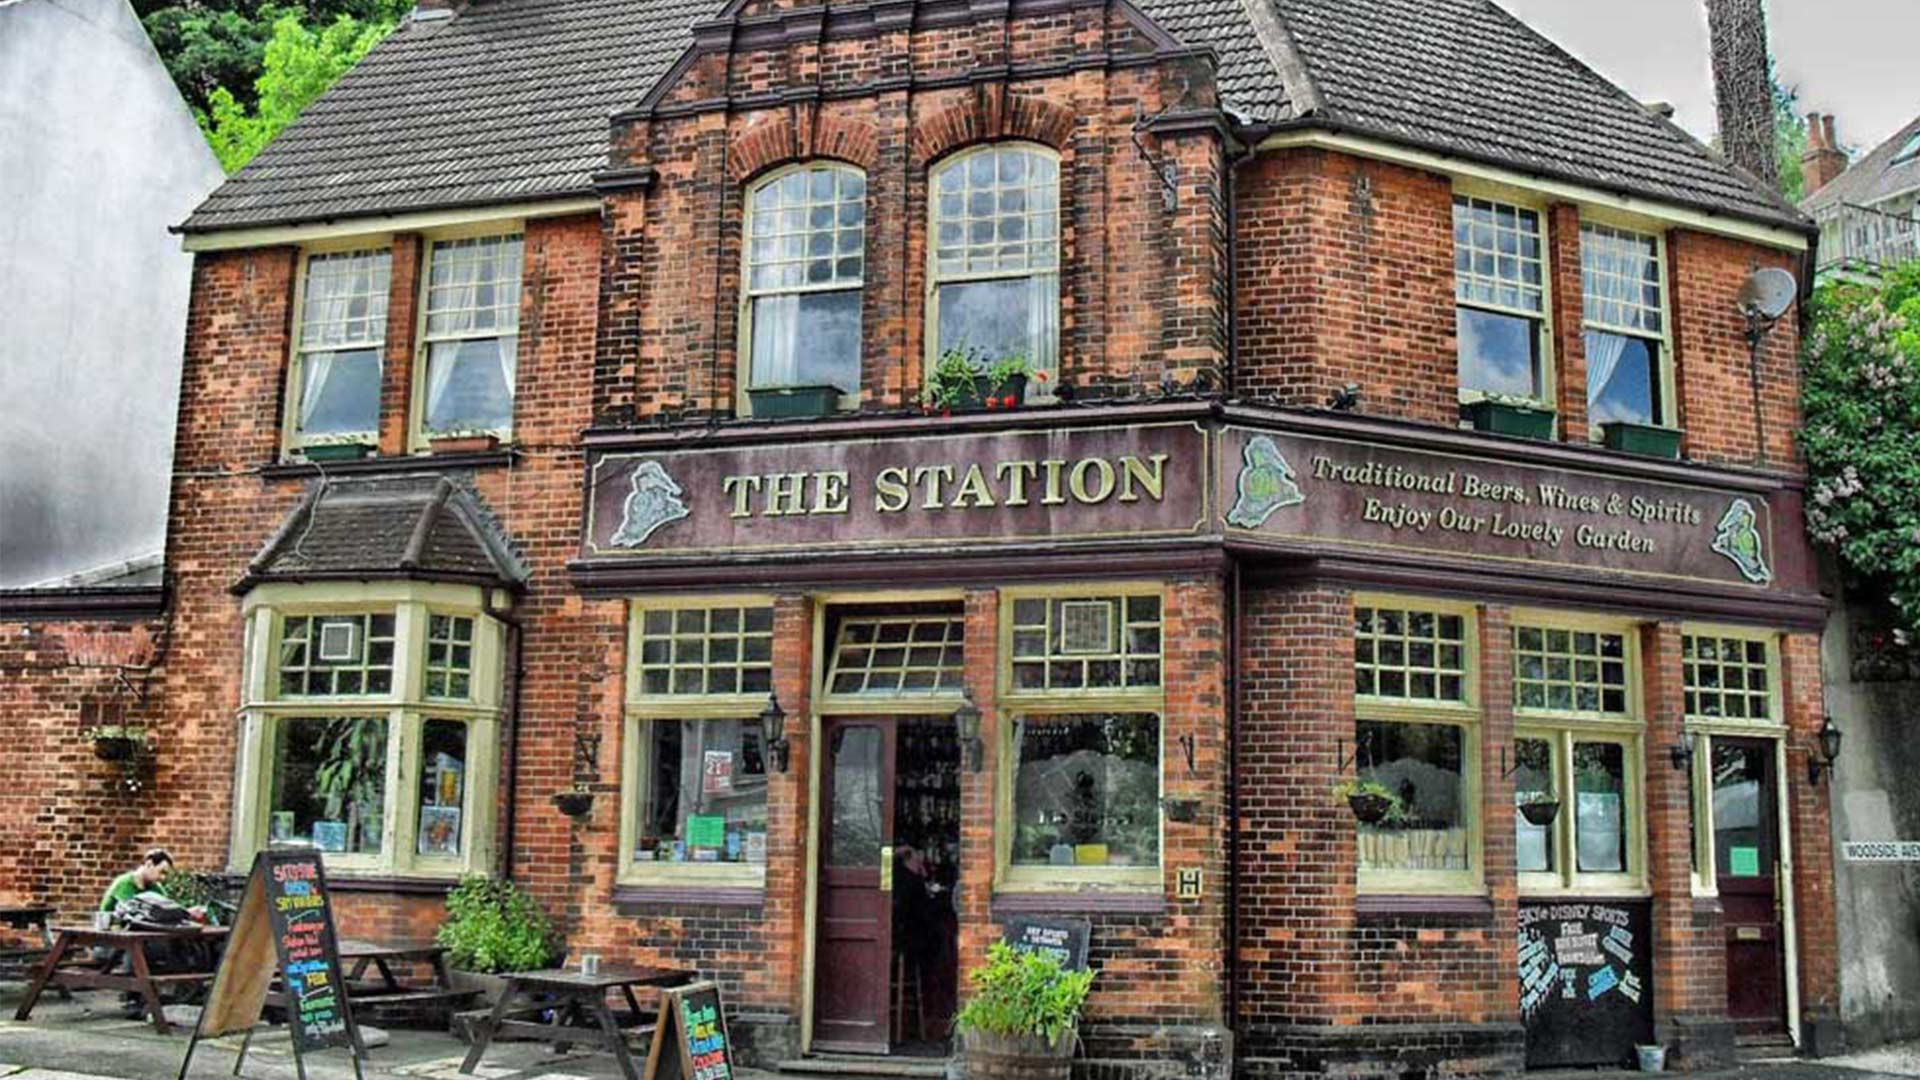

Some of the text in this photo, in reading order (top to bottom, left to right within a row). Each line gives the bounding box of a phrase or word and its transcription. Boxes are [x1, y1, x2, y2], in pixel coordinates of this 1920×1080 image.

[723, 455, 1168, 518] THE STATION
[1312, 456, 1455, 493] Traditional
[1538, 484, 1600, 513] Wines
[1607, 493, 1623, 514] &
[1629, 495, 1701, 525] Spirits
[1363, 497, 1654, 553] Enjoy Our Lovely Garden
[1848, 844, 1897, 858] WOODSIDE
[1179, 870, 1199, 895] H
